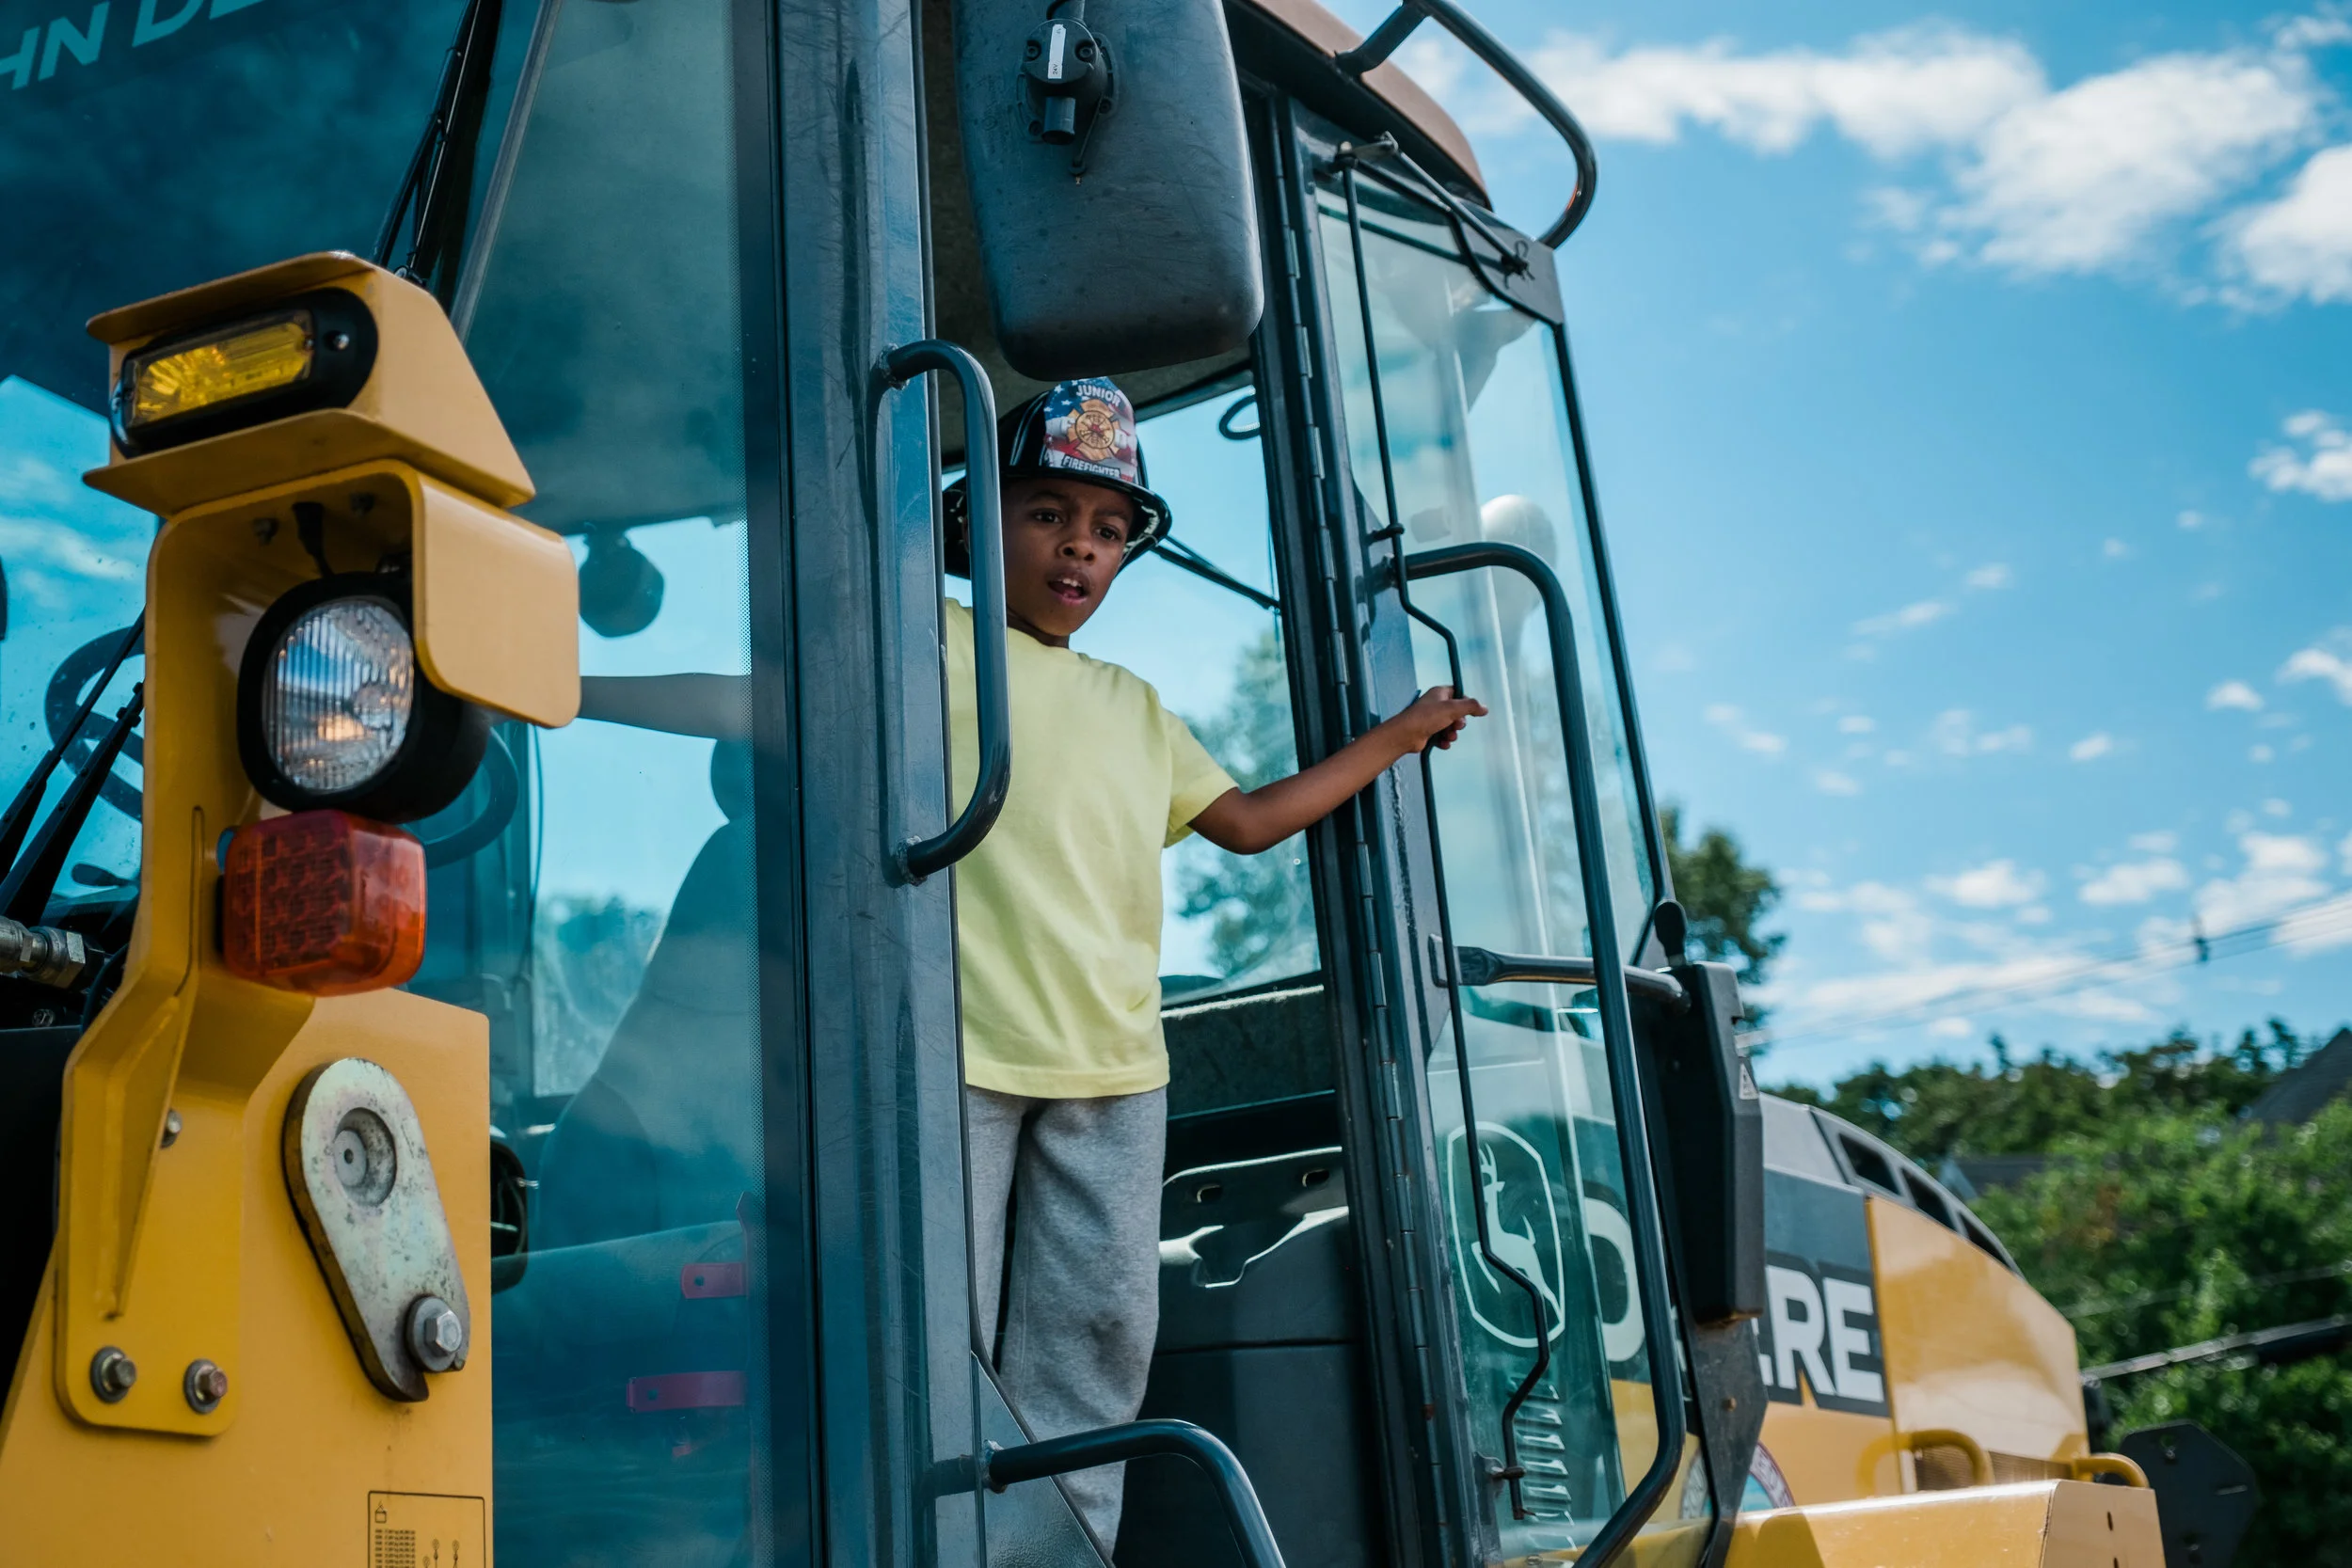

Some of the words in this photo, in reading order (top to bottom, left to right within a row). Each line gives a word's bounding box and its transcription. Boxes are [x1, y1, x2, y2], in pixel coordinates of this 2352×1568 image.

[1075, 385, 1121, 406] JUNIOR
[1062, 456, 1120, 477] FIREFIGHTER
[1583, 1197, 1884, 1403] DRE
